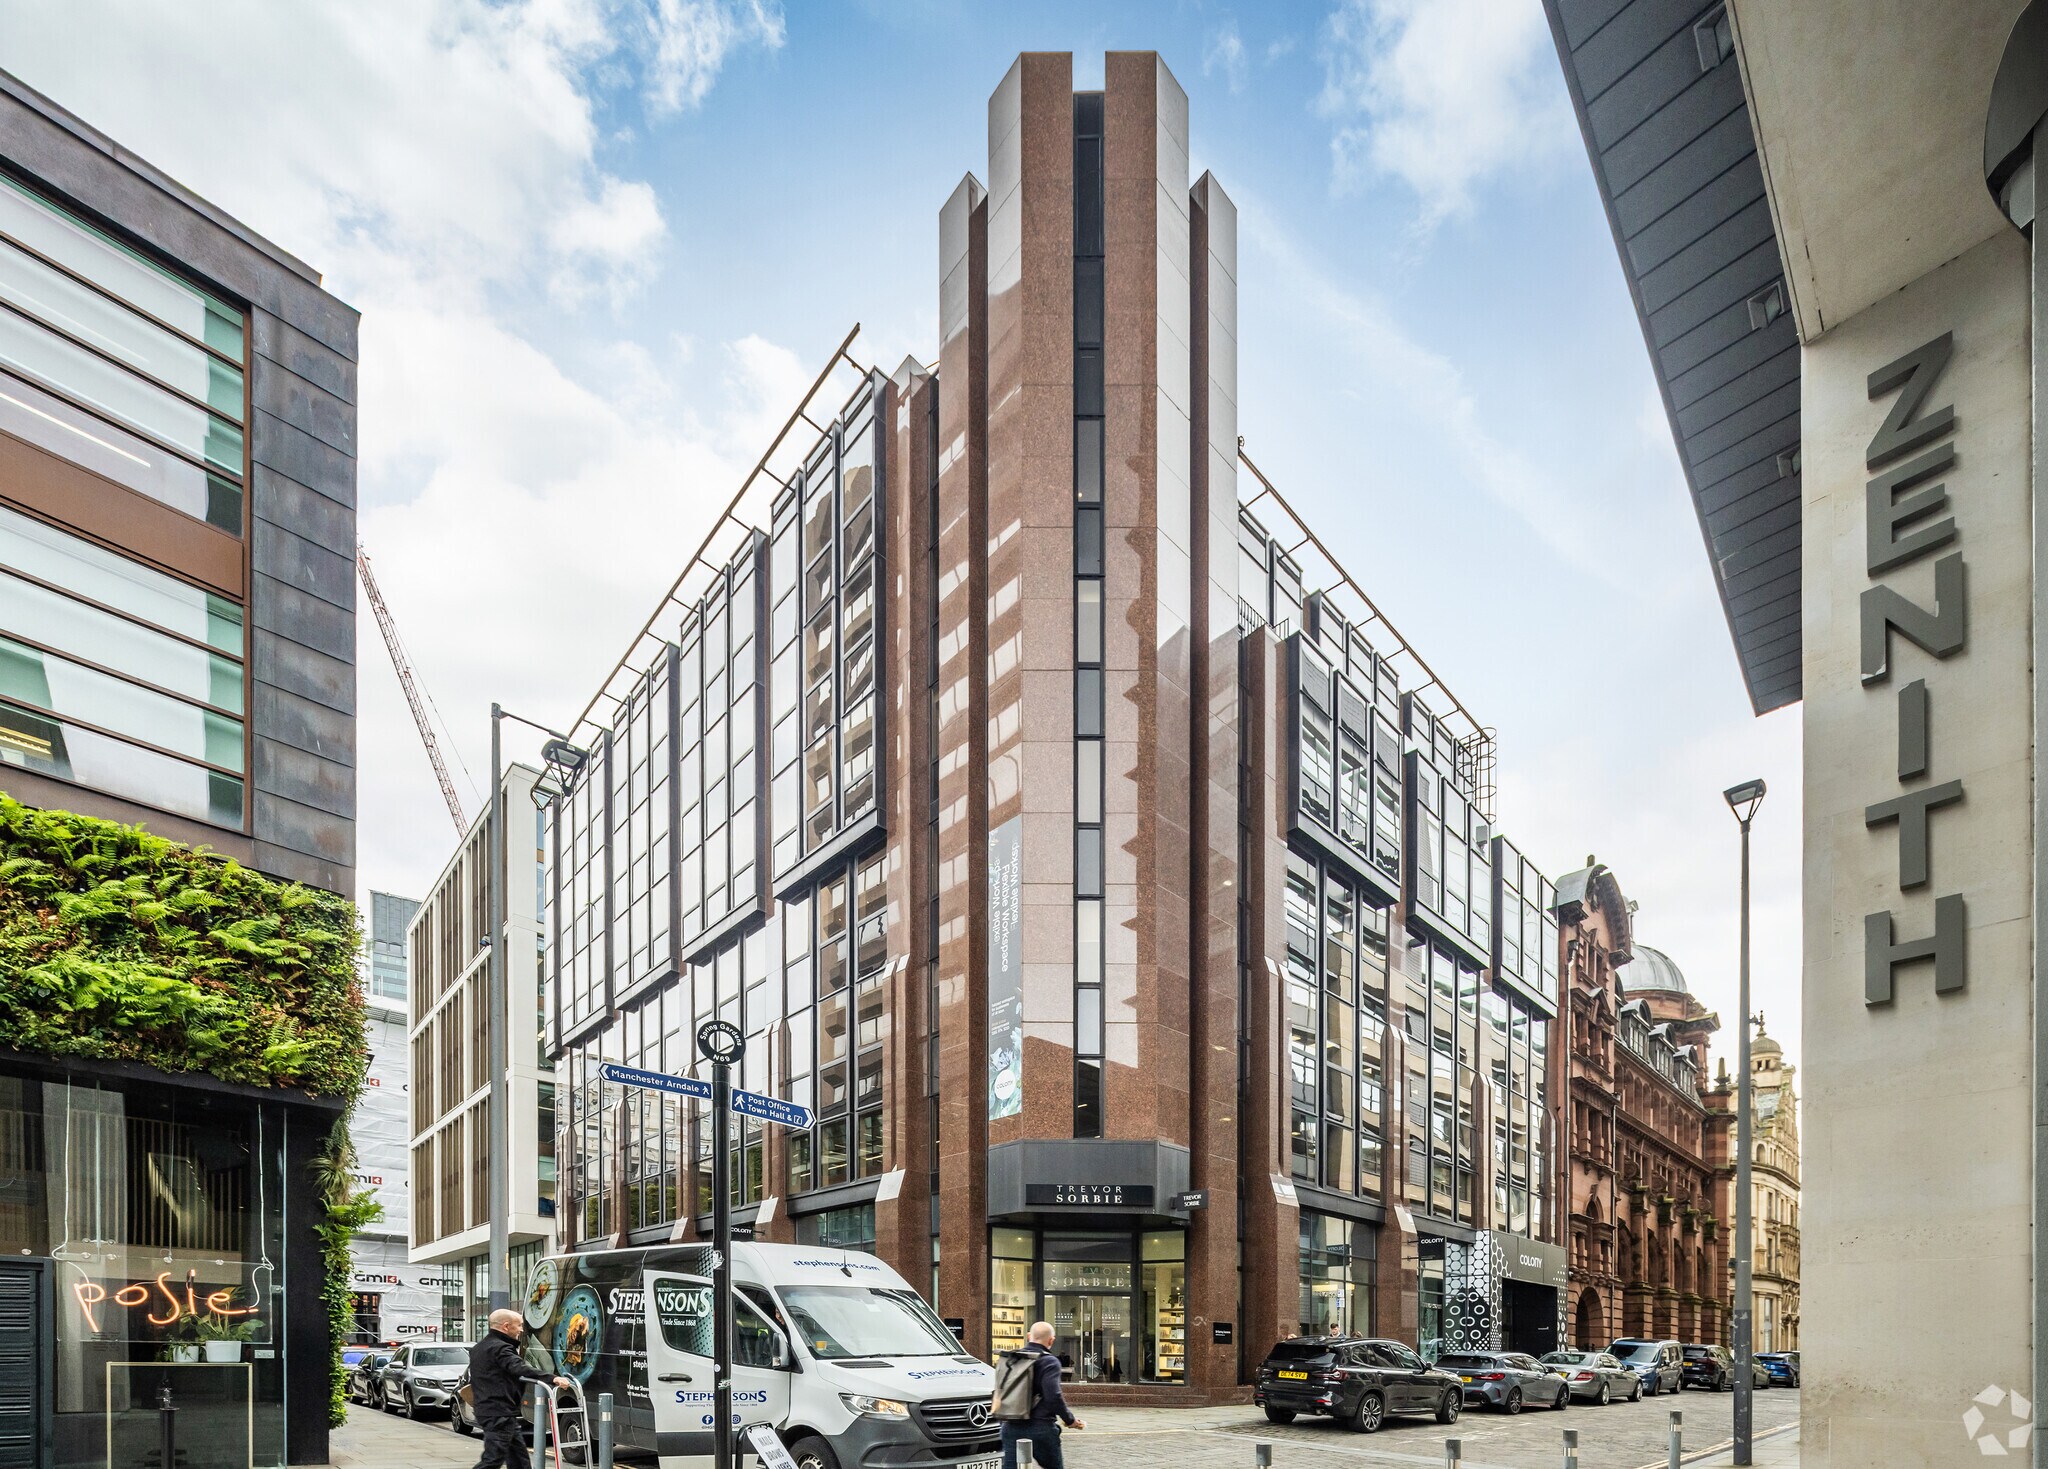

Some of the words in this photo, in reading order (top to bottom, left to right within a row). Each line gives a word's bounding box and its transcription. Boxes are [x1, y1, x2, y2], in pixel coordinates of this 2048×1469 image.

[1859, 329, 1964, 1007] ZENITH
[1001, 864, 1010, 907] Flexible
[1001, 909, 1010, 973] Workspace
[700, 1024, 718, 1040] Spring
[720, 1023, 742, 1046] Gardens
[712, 1054, 731, 1062] N69
[611, 1069, 664, 1087] Manchester
[667, 1079, 699, 1093] Arndale
[748, 1096, 766, 1107] Post
[767, 1100, 791, 1113] Office
[747, 1104, 767, 1115] Town
[769, 1109, 785, 1120] Hall
[1056, 1185, 1122, 1194] TREVOR
[1056, 1194, 1123, 1204] SORBIE
[794, 1259, 881, 1272] stephensons.com
[1520, 1254, 1542, 1268] COLONY
[1050, 1277, 1125, 1287] SORBIE
[606, 1287, 713, 1318] STEPHNSONS
[615, 1316, 635, 1325] Supporting
[674, 1318, 685, 1326] Since
[685, 1319, 697, 1327] 1868
[675, 1390, 767, 1404] STEPHSONS
